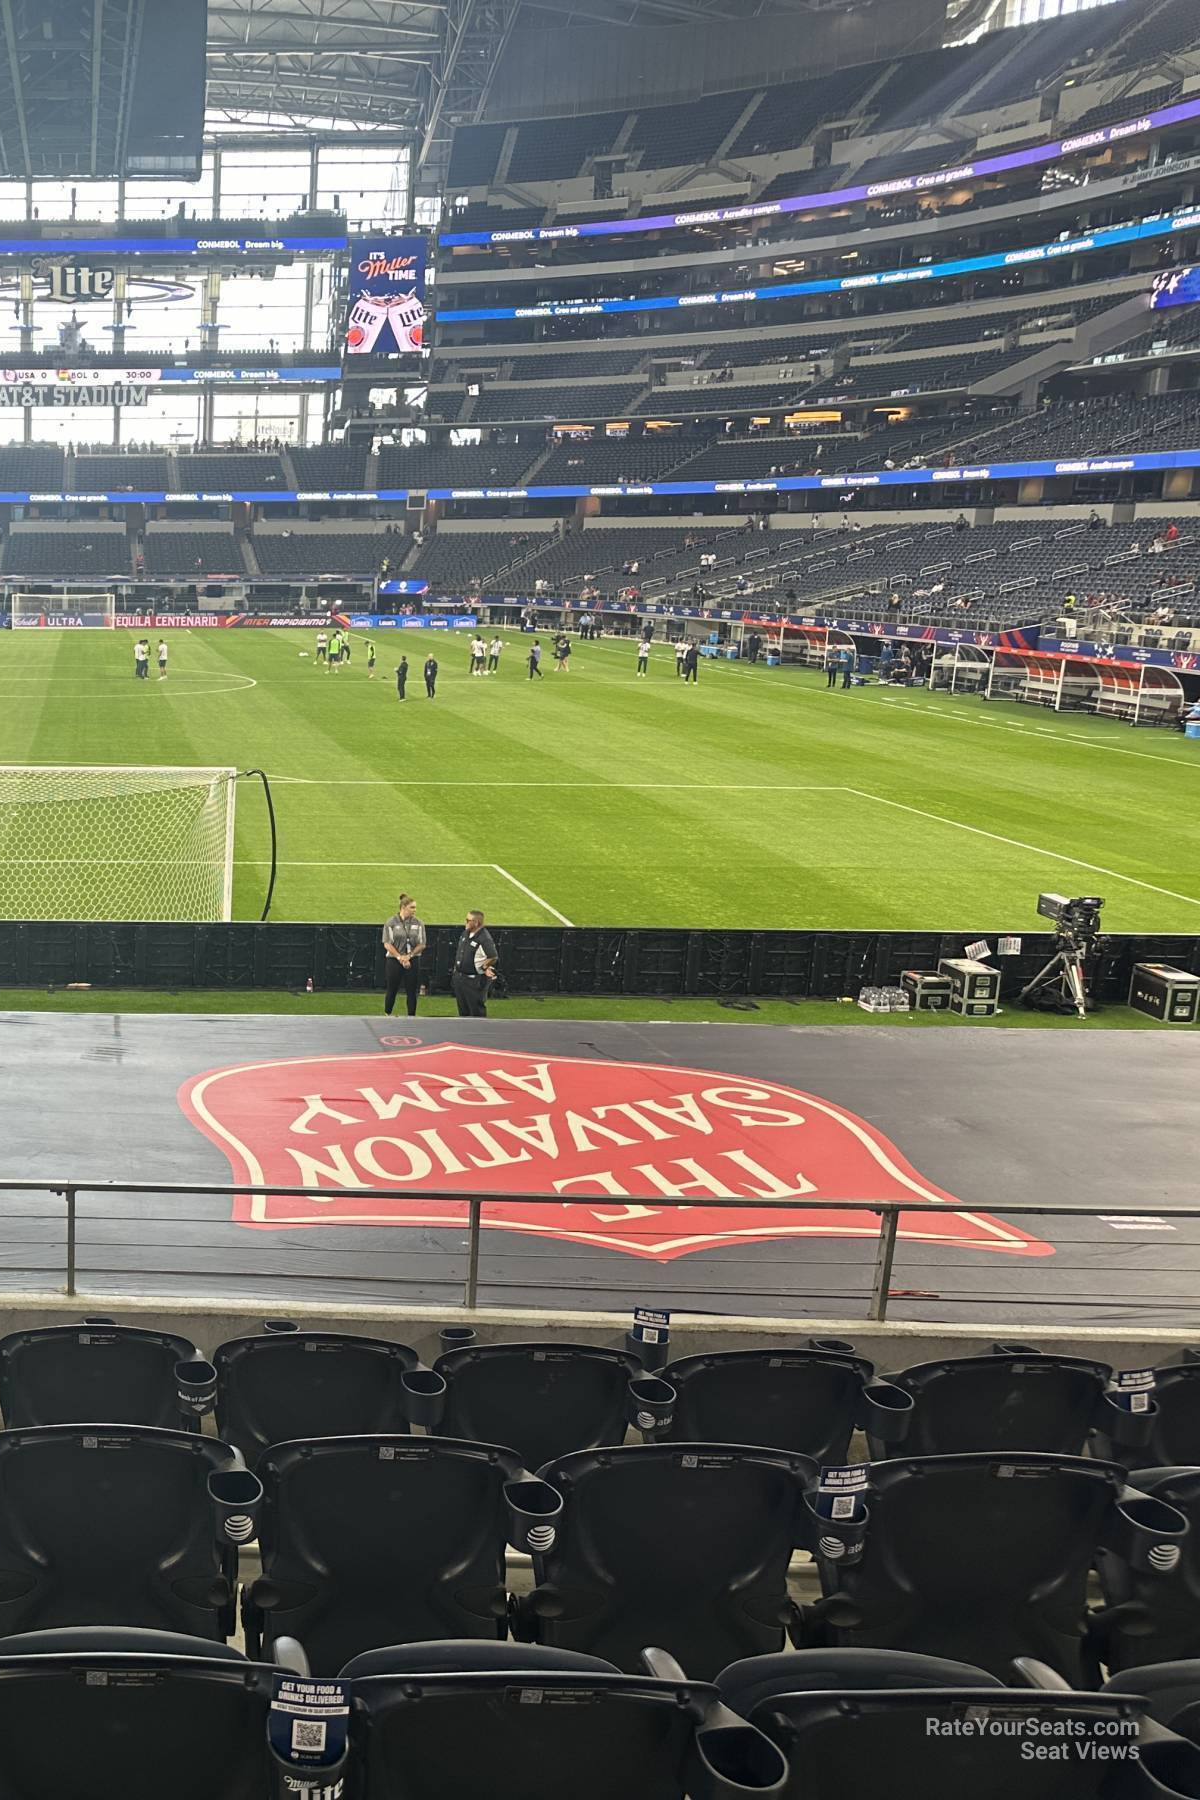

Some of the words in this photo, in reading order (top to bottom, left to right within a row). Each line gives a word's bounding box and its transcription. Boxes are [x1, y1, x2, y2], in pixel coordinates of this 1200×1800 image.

[1061, 132, 1105, 152] CONMEBOL
[1110, 124, 1137, 139] Dream
[1154, 161, 1190, 177] JOHNSON
[867, 180, 914, 196] CONMEBOL
[674, 212, 720, 224] CONMEBOL
[491, 232, 534, 241] CONMEBOL
[540, 230, 564, 238] Dream
[565, 228, 579, 237] big.
[271, 240, 284, 249] big.
[369, 252, 385, 260] IT'S
[358, 256, 418, 280] Miller
[388, 270, 417, 280] TIME
[48, 266, 113, 302] Lite
[678, 295, 717, 305] CONMEBOL
[352, 307, 378, 325] Lite
[399, 306, 424, 327] Lite
[515, 307, 552, 317] CONMEBOL
[266, 370, 280, 379] big.
[53, 385, 148, 407] STADIUM
[48, 618, 83, 626] ULTRA
[156, 616, 218, 626] CENTENARIO
[289, 1061, 558, 1136] ARMY
[284, 1085, 807, 1203] SALVATION
[553, 1148, 820, 1224] THE
[282, 1682, 294, 1690] GET
[296, 1684, 315, 1693] YOUR
[316, 1686, 335, 1694] FOOD
[278, 1691, 304, 1702] DRINKS
[306, 1695, 344, 1704] DELIVERED!
[284, 1775, 319, 1788] Miller
[287, 1778, 344, 1800] Lite
